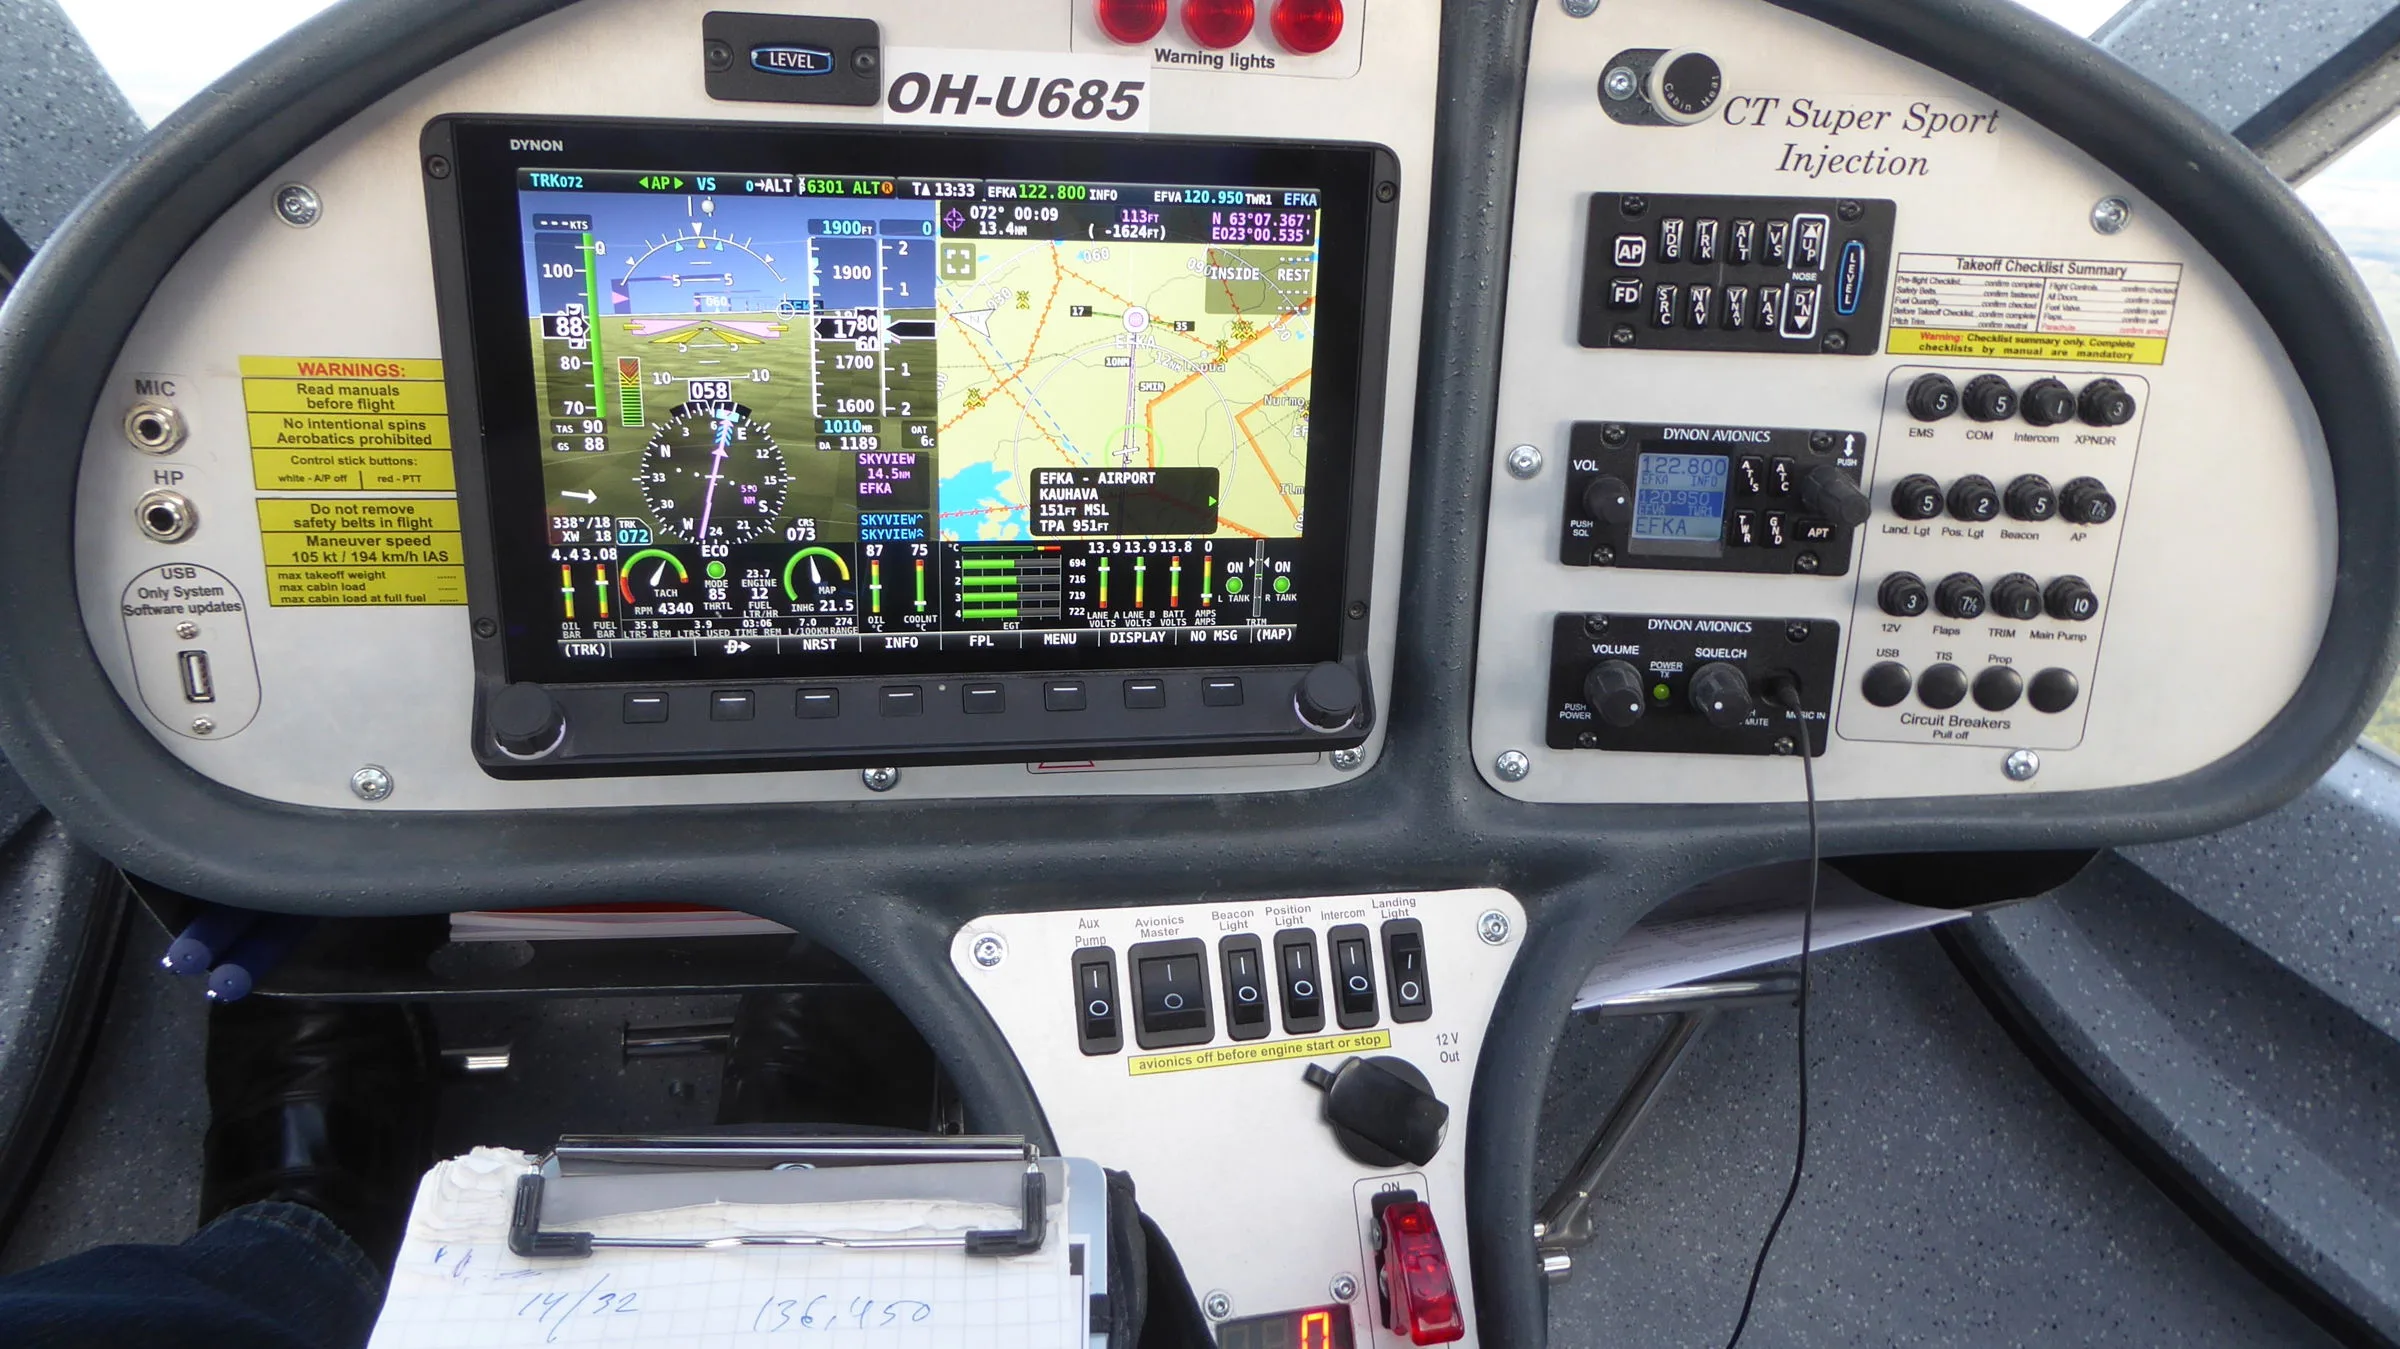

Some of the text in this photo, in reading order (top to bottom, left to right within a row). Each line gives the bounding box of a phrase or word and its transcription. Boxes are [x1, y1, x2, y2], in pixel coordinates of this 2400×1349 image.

[770, 51, 814, 69] LEVEL
[1155, 48, 1276, 72] Warning lights
[887, 73, 1144, 121] OH-U685
[1663, 82, 1692, 112] Cabin
[1724, 97, 1999, 139] CT Super Sport
[510, 139, 563, 151] DYNON
[1776, 143, 1930, 176] Injection
[651, 177, 716, 191] AP VS
[807, 180, 880, 195] 6301 ALT
[935, 183, 975, 197] 13:33
[988, 184, 1117, 201] EFKA 122.800 INFO
[1154, 190, 1272, 205] EFVA 120.950 TWR1
[1284, 192, 1317, 206] EFKA
[1014, 207, 1058, 222] 00:09
[1619, 245, 1641, 260] AP
[543, 264, 573, 278] 100
[833, 266, 871, 280] 1900
[1211, 267, 1310, 281] INSIDE REST
[1957, 258, 2127, 279] Takeoff Checklist Summary
[1793, 272, 1817, 281] NOSE
[1615, 287, 1637, 303] FD
[556, 317, 583, 337] 88
[1919, 343, 2134, 360] checklists manual mandatory
[560, 356, 580, 370] 80
[836, 355, 873, 369] 1700
[299, 363, 405, 377] WARNINGS:
[136, 379, 176, 397] MIC
[298, 383, 399, 396] Read manuals
[691, 382, 728, 400] 058
[308, 398, 395, 412] before flight
[564, 401, 584, 415] 70
[836, 399, 875, 413] 1600
[284, 419, 426, 433] No intentional spins
[556, 420, 603, 434] TAS 90
[1664, 428, 1771, 443] DYNON AVIONICS
[1909, 428, 1934, 438] EMS
[1966, 430, 1994, 440] COM
[2014, 432, 2059, 443] Intercom
[277, 433, 431, 447] Aerobatics prohibited
[585, 438, 605, 451] 88
[840, 437, 877, 450] 1189
[2075, 435, 2117, 446] XPNDR
[859, 453, 915, 465] SKYVIEW
[1573, 459, 1598, 471] VOL
[1643, 456, 1726, 476] 122.800
[154, 471, 184, 485] HP
[1040, 472, 1155, 485] EFKA AIRPORT
[860, 483, 892, 494] EFKA
[1040, 488, 1098, 501] KAUHAVA
[311, 504, 414, 515] Do not remove
[1040, 504, 1109, 516] 151FT MSL
[294, 517, 432, 530] safety belts in flight
[619, 520, 636, 529] TRK
[798, 518, 814, 528] CRS
[1040, 519, 1108, 532] TPA 951FT
[1570, 520, 1593, 529] PUSH
[1636, 517, 1687, 536] EFKA
[563, 530, 611, 543] XW 18
[619, 529, 649, 544] 072
[787, 527, 816, 541] 073
[1573, 529, 1589, 537] SQL
[1808, 527, 1829, 539] APT
[2000, 531, 2039, 540] Beacon
[307, 536, 431, 549] Maneuver speed
[292, 551, 448, 563] 105 kt 194 km/h IAS
[702, 545, 728, 557] ECO
[161, 568, 196, 579] USB
[138, 586, 223, 600] Only System
[654, 589, 678, 598] TACH
[752, 588, 768, 600] 12
[819, 586, 836, 595] MAP
[124, 602, 241, 616] Software updates
[658, 602, 693, 615] 4340
[820, 599, 853, 612] 21.5
[1648, 619, 1752, 634] DYNON AVIONICS
[1881, 624, 1901, 633] 12V
[1933, 626, 1961, 637] Flaps
[1988, 628, 2016, 638] TRIM
[969, 634, 994, 647] FPL
[1044, 632, 1076, 645] MENU
[1110, 630, 1166, 644] DISPLAY
[1190, 629, 1238, 643] NO MSG
[1255, 628, 1293, 643] (MAP)
[2030, 630, 2087, 642] Main Pump
[803, 638, 837, 651] NRST
[885, 636, 918, 649] INFO
[565, 643, 606, 658] (TRK)
[1592, 645, 1639, 656] VOLUME
[1695, 648, 1747, 659] SQUELCH
[1650, 661, 1683, 670] POWER
[1901, 713, 2011, 730] Circuit Breakers
[1265, 903, 1311, 917] Position
[1371, 897, 1416, 911] Landing
[1212, 908, 1254, 922] Beacon
[1321, 908, 1365, 921] Intercom
[1381, 907, 1409, 919] Light
[1078, 917, 1100, 930] Aux
[1135, 915, 1184, 928] Avionics
[1219, 919, 1248, 932] Light
[1275, 914, 1304, 927] Light
[1140, 926, 1179, 938] Master
[1075, 934, 1107, 948] Pump
[1436, 1033, 1458, 1046] 12 V
[1139, 1034, 1381, 1071] avionics off before engine start or stop
[1440, 1051, 1459, 1063] Out
[1382, 1182, 1400, 1193] ON
